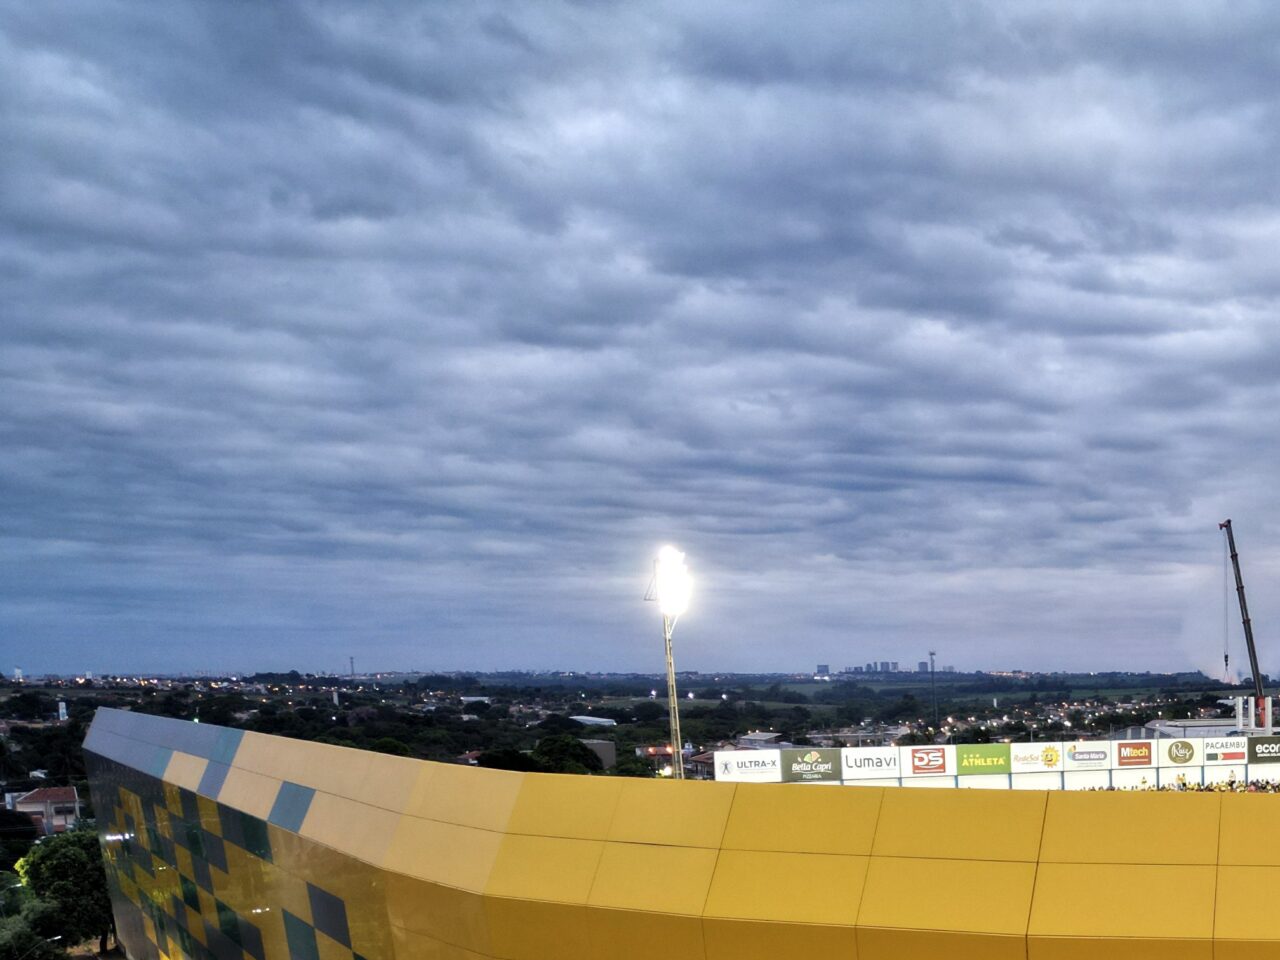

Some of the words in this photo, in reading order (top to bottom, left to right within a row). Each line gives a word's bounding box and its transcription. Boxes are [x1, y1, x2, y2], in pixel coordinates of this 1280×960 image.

[1205, 741, 1246, 750] PACAEMBU
[1120, 746, 1149, 757] Mtech
[737, 759, 777, 769] ULTRA-X
[845, 753, 897, 769] Lumavi
[914, 752, 944, 766] DS
[962, 757, 1005, 767] ATHLETA
[792, 763, 811, 772] Bella
